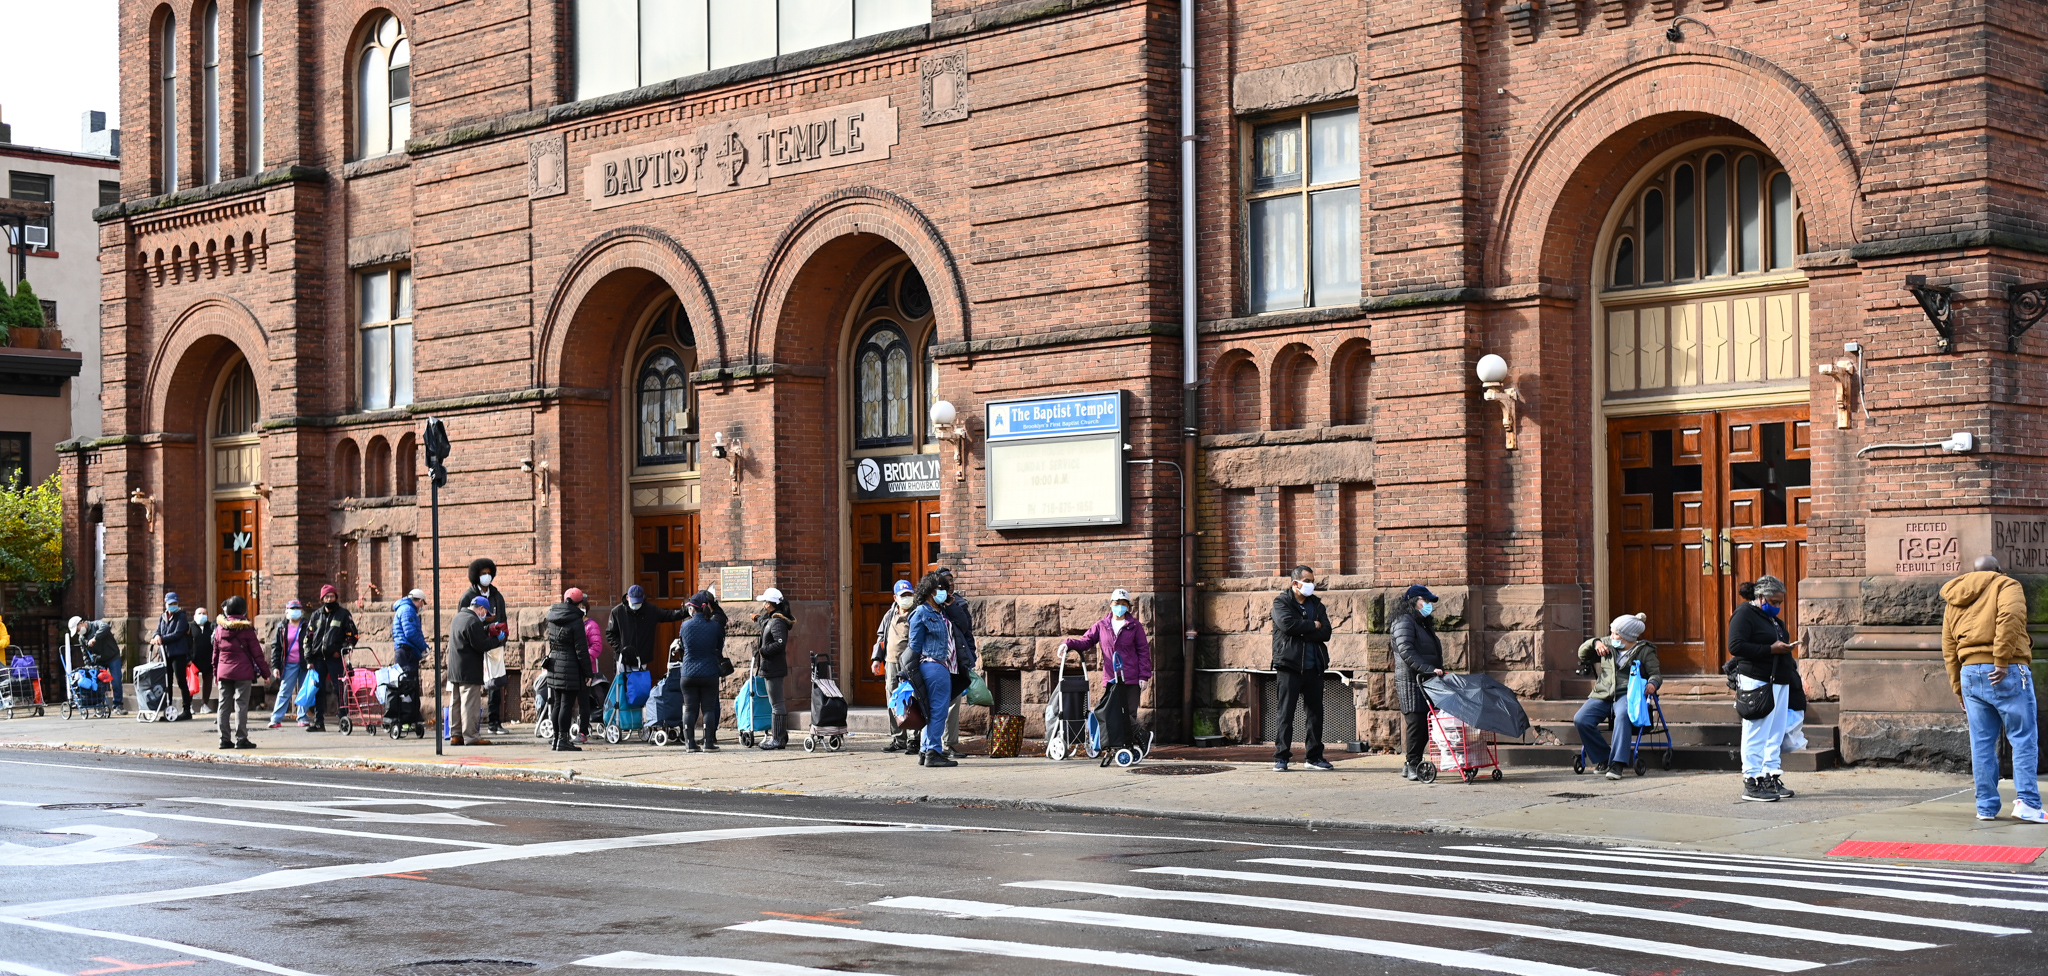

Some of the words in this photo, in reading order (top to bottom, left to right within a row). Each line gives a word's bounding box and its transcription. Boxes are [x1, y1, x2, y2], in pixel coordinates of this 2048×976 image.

[603, 142, 708, 197] BAPTIST
[758, 113, 864, 168] TEMPLE
[1012, 408, 1030, 421] The
[1033, 404, 1071, 423] Baptist
[1075, 401, 1114, 419] Temple
[1016, 461, 1045, 473] SUNDAY
[1049, 458, 1080, 471] SERVICE
[1031, 475, 1052, 486] 10:00
[1906, 522, 1947, 532] ERECTED
[1994, 520, 2047, 549] BAPTIST
[1898, 537, 1958, 561] 1894
[1895, 562, 1936, 573] REBUILT
[1942, 561, 1961, 572] 1917
